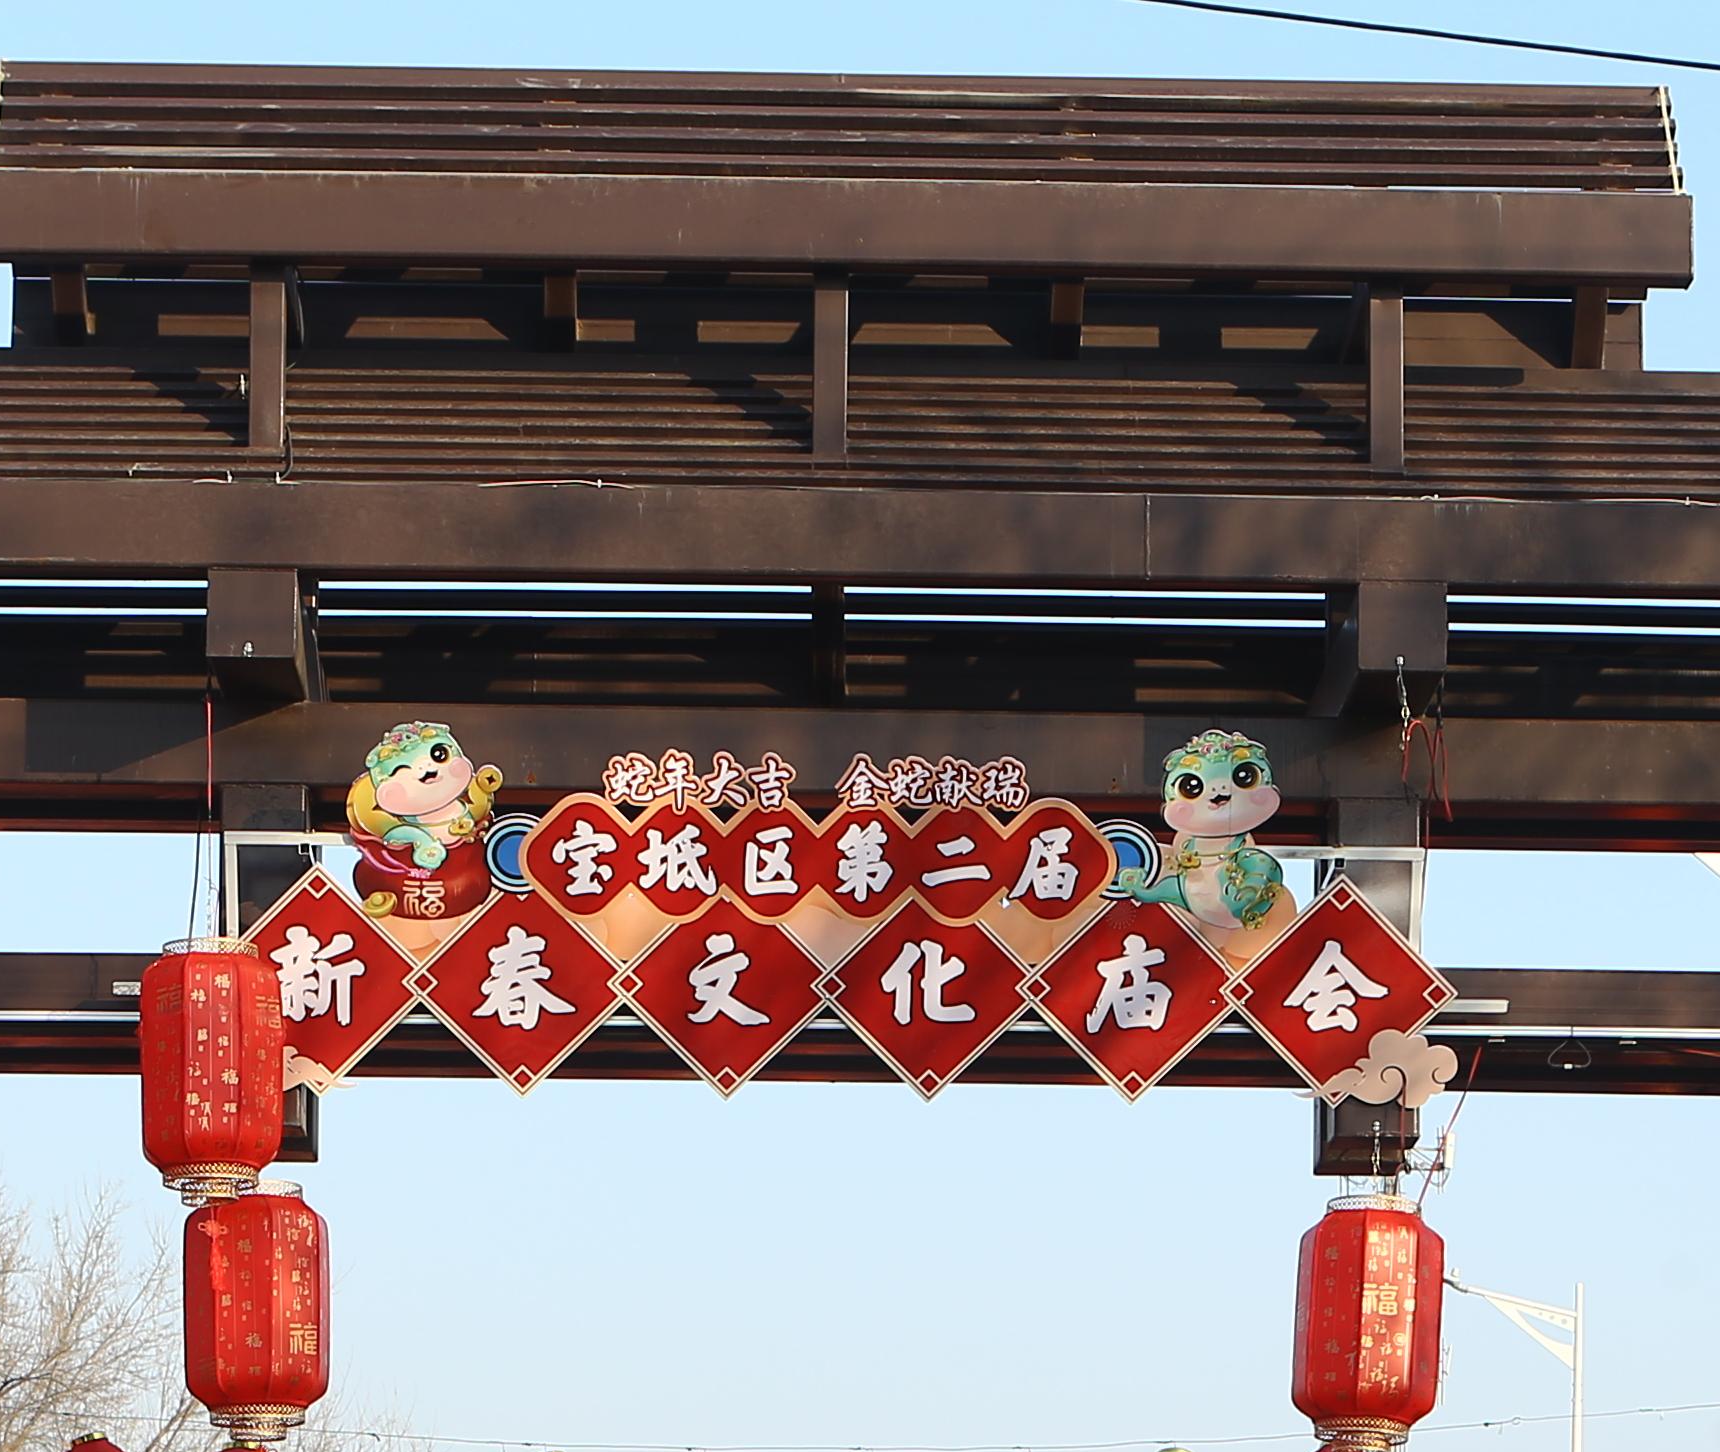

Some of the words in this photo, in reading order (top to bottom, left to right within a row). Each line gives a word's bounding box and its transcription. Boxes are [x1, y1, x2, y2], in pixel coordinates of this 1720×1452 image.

[604, 750, 796, 812] 蛇年大吉
[838, 753, 1028, 810] 金蛇献瑞
[551, 818, 1083, 902] 宝坻区第二届
[270, 925, 1391, 1034] 新春文化庙会
